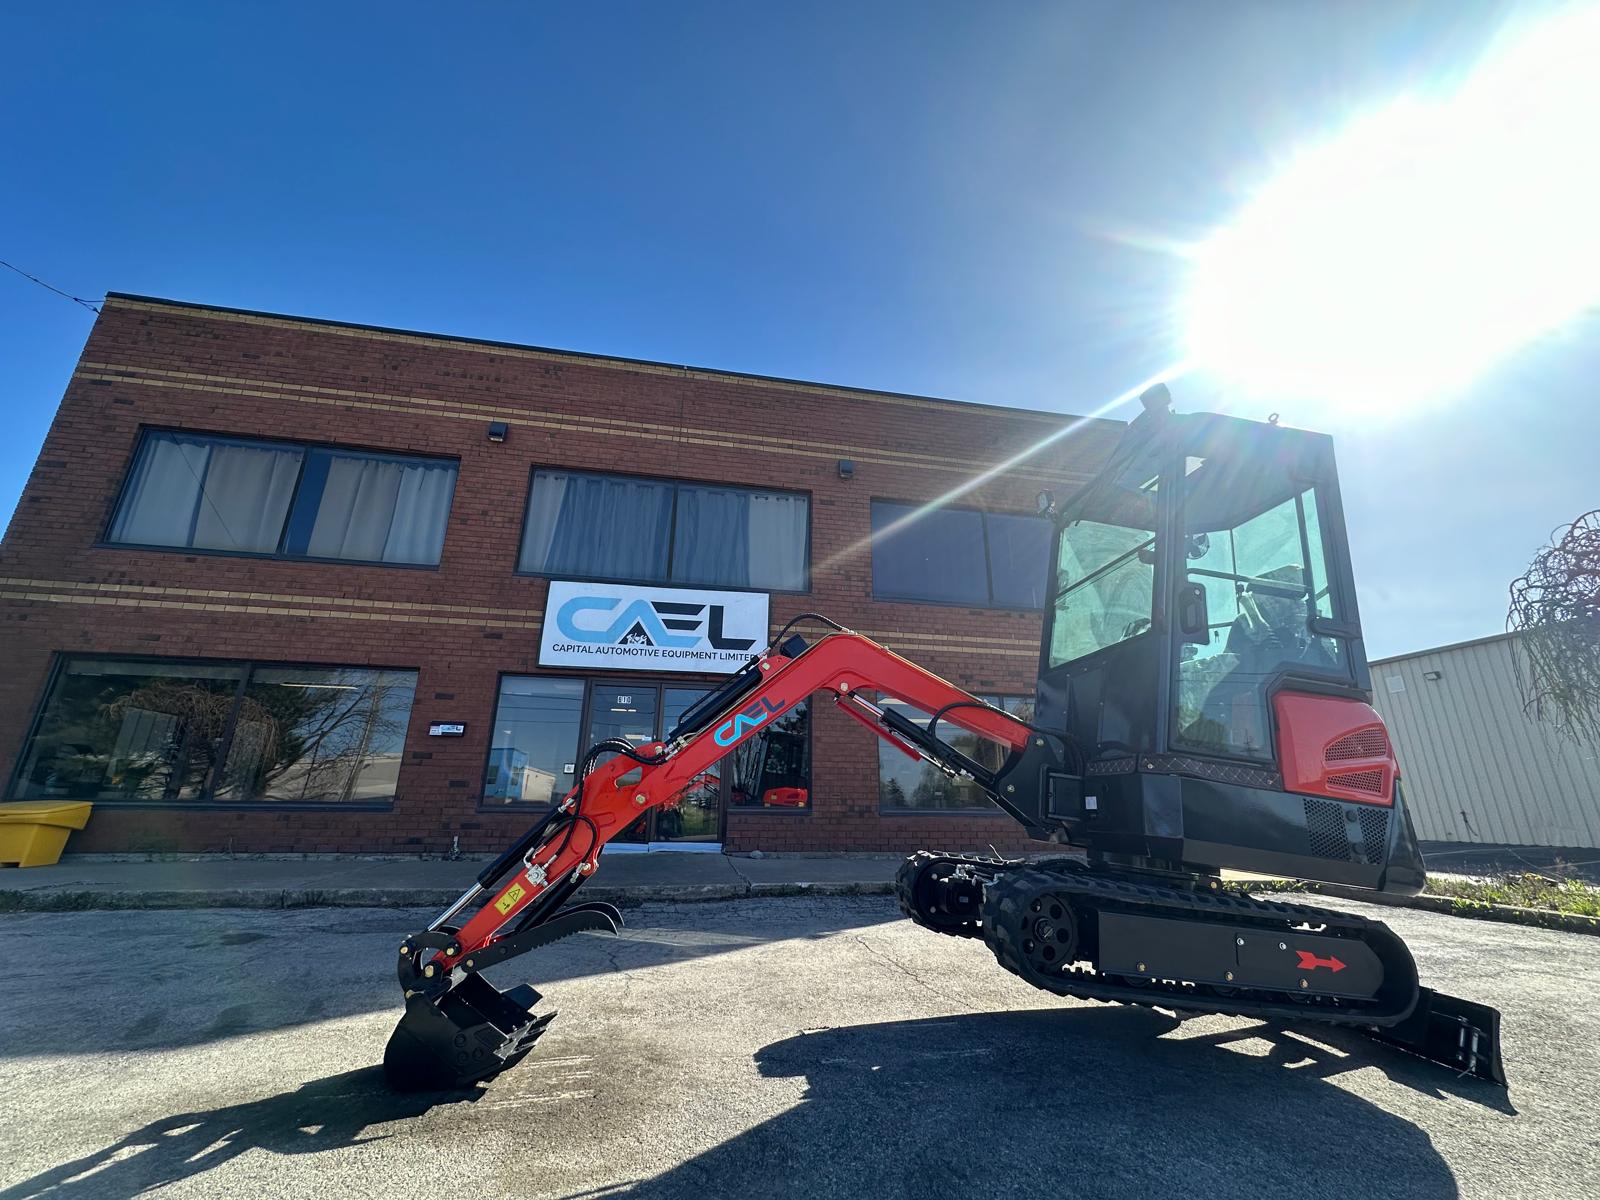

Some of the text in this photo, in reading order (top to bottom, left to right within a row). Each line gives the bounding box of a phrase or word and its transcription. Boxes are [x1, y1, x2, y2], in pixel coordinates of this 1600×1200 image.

[556, 596, 757, 650] CAEL
[552, 643, 594, 654] CAPITAL
[595, 646, 660, 657] AUTOMOTIVE
[661, 649, 717, 661] EQUIPMENT
[714, 696, 785, 746] CAEL
